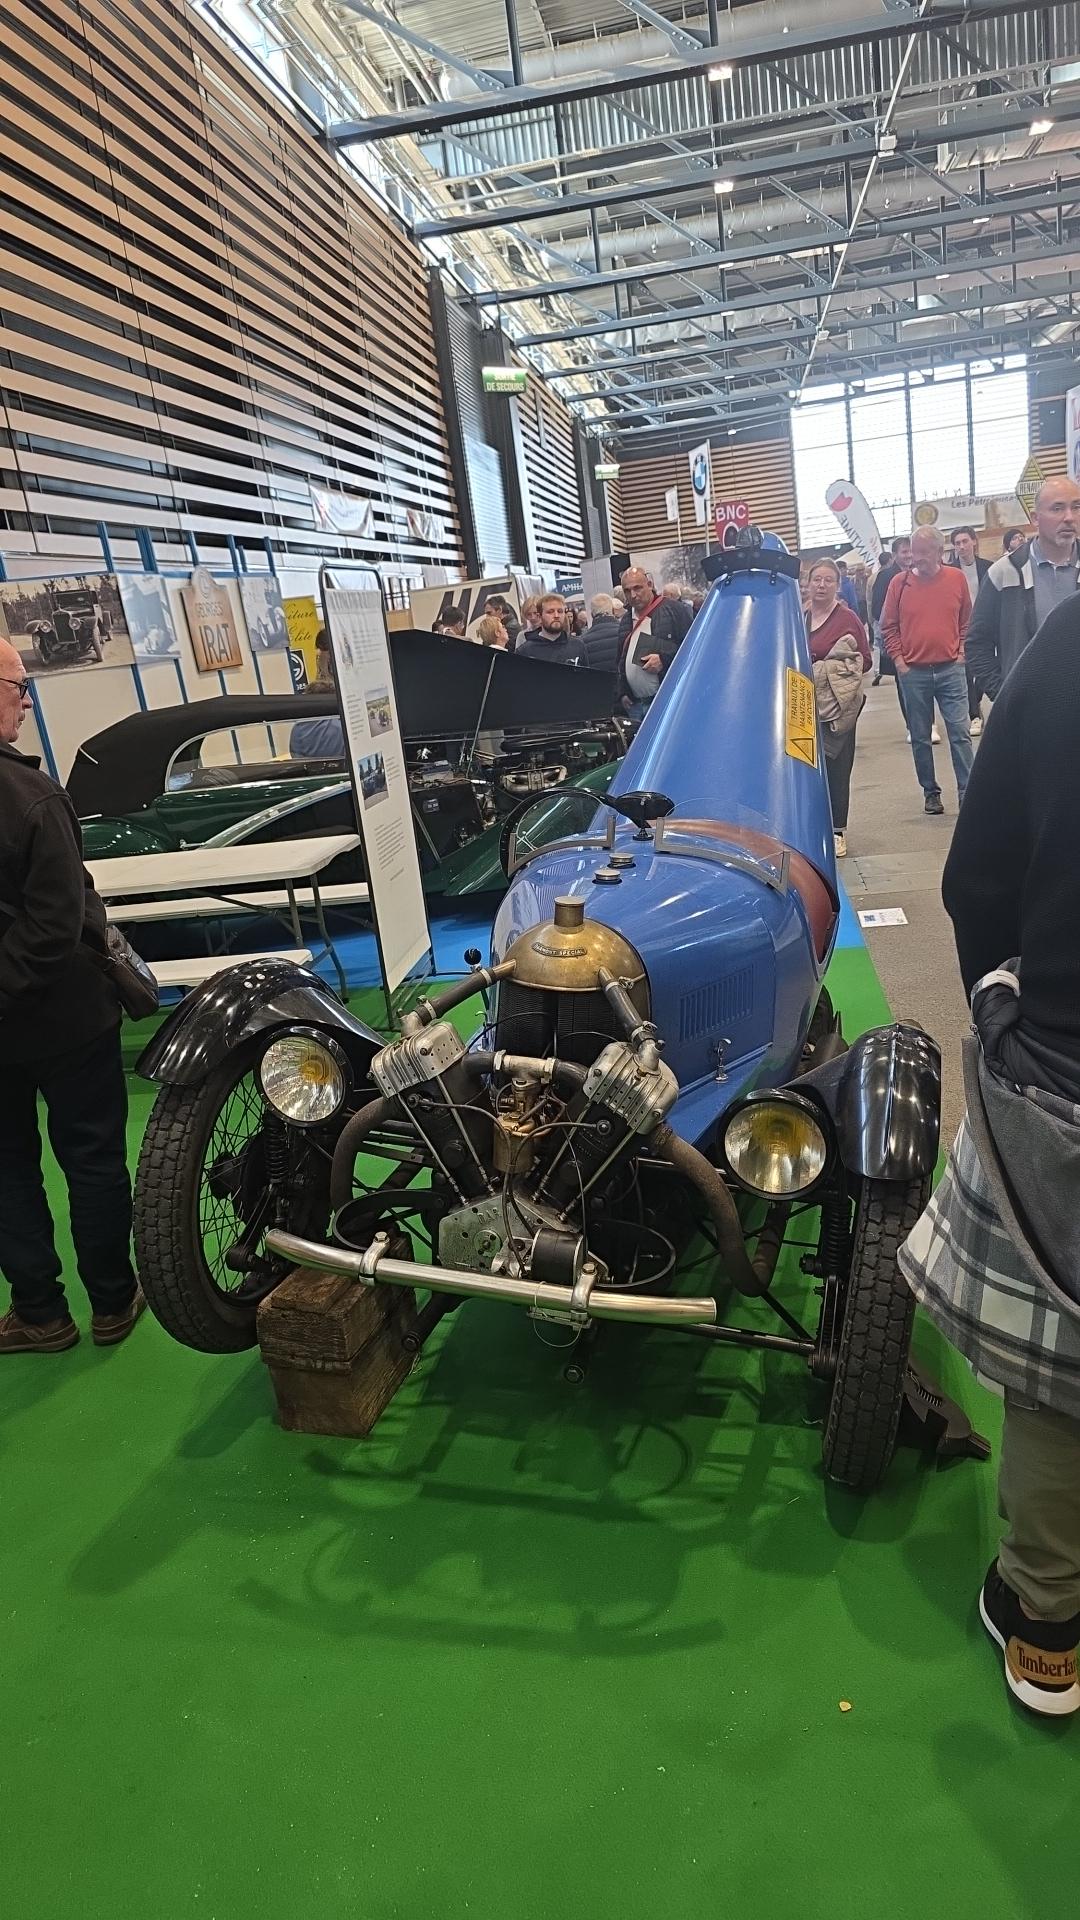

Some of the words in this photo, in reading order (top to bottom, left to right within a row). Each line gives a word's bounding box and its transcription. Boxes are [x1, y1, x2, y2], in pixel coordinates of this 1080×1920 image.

[486, 382, 497, 391] DE
[497, 382, 524, 391] SECOURS
[951, 500, 967, 509] Les
[715, 504, 746, 522] BNC
[199, 623, 234, 665] IRAT
[791, 676, 798, 687] DE
[806, 714, 812, 725] EN
